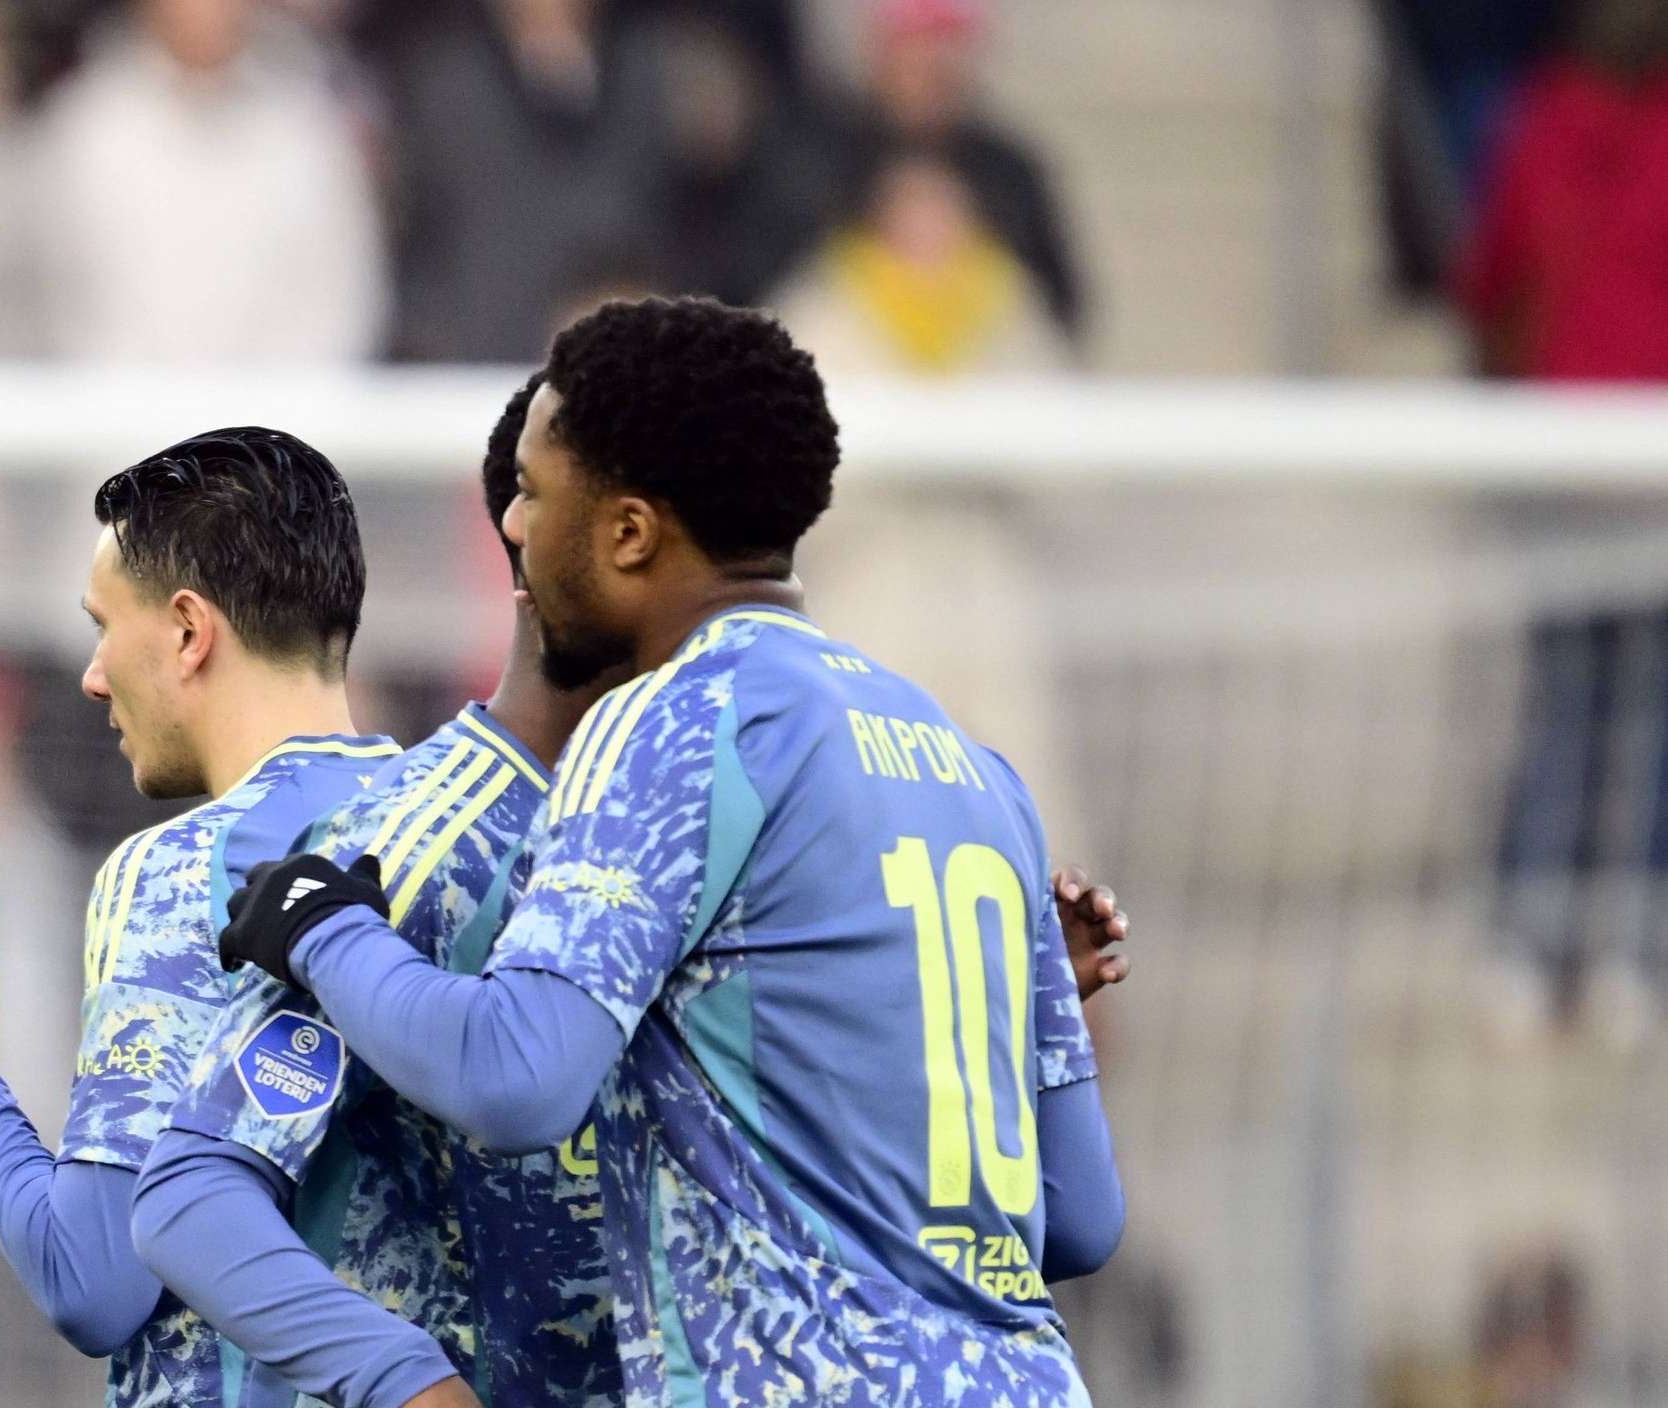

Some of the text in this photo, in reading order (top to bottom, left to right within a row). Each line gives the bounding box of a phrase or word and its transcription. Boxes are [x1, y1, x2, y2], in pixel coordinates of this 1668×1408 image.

[881, 837, 1037, 1214] 10
[254, 1052, 327, 1095] VRIENDEN
[254, 1069, 312, 1104] LOTERIJ
